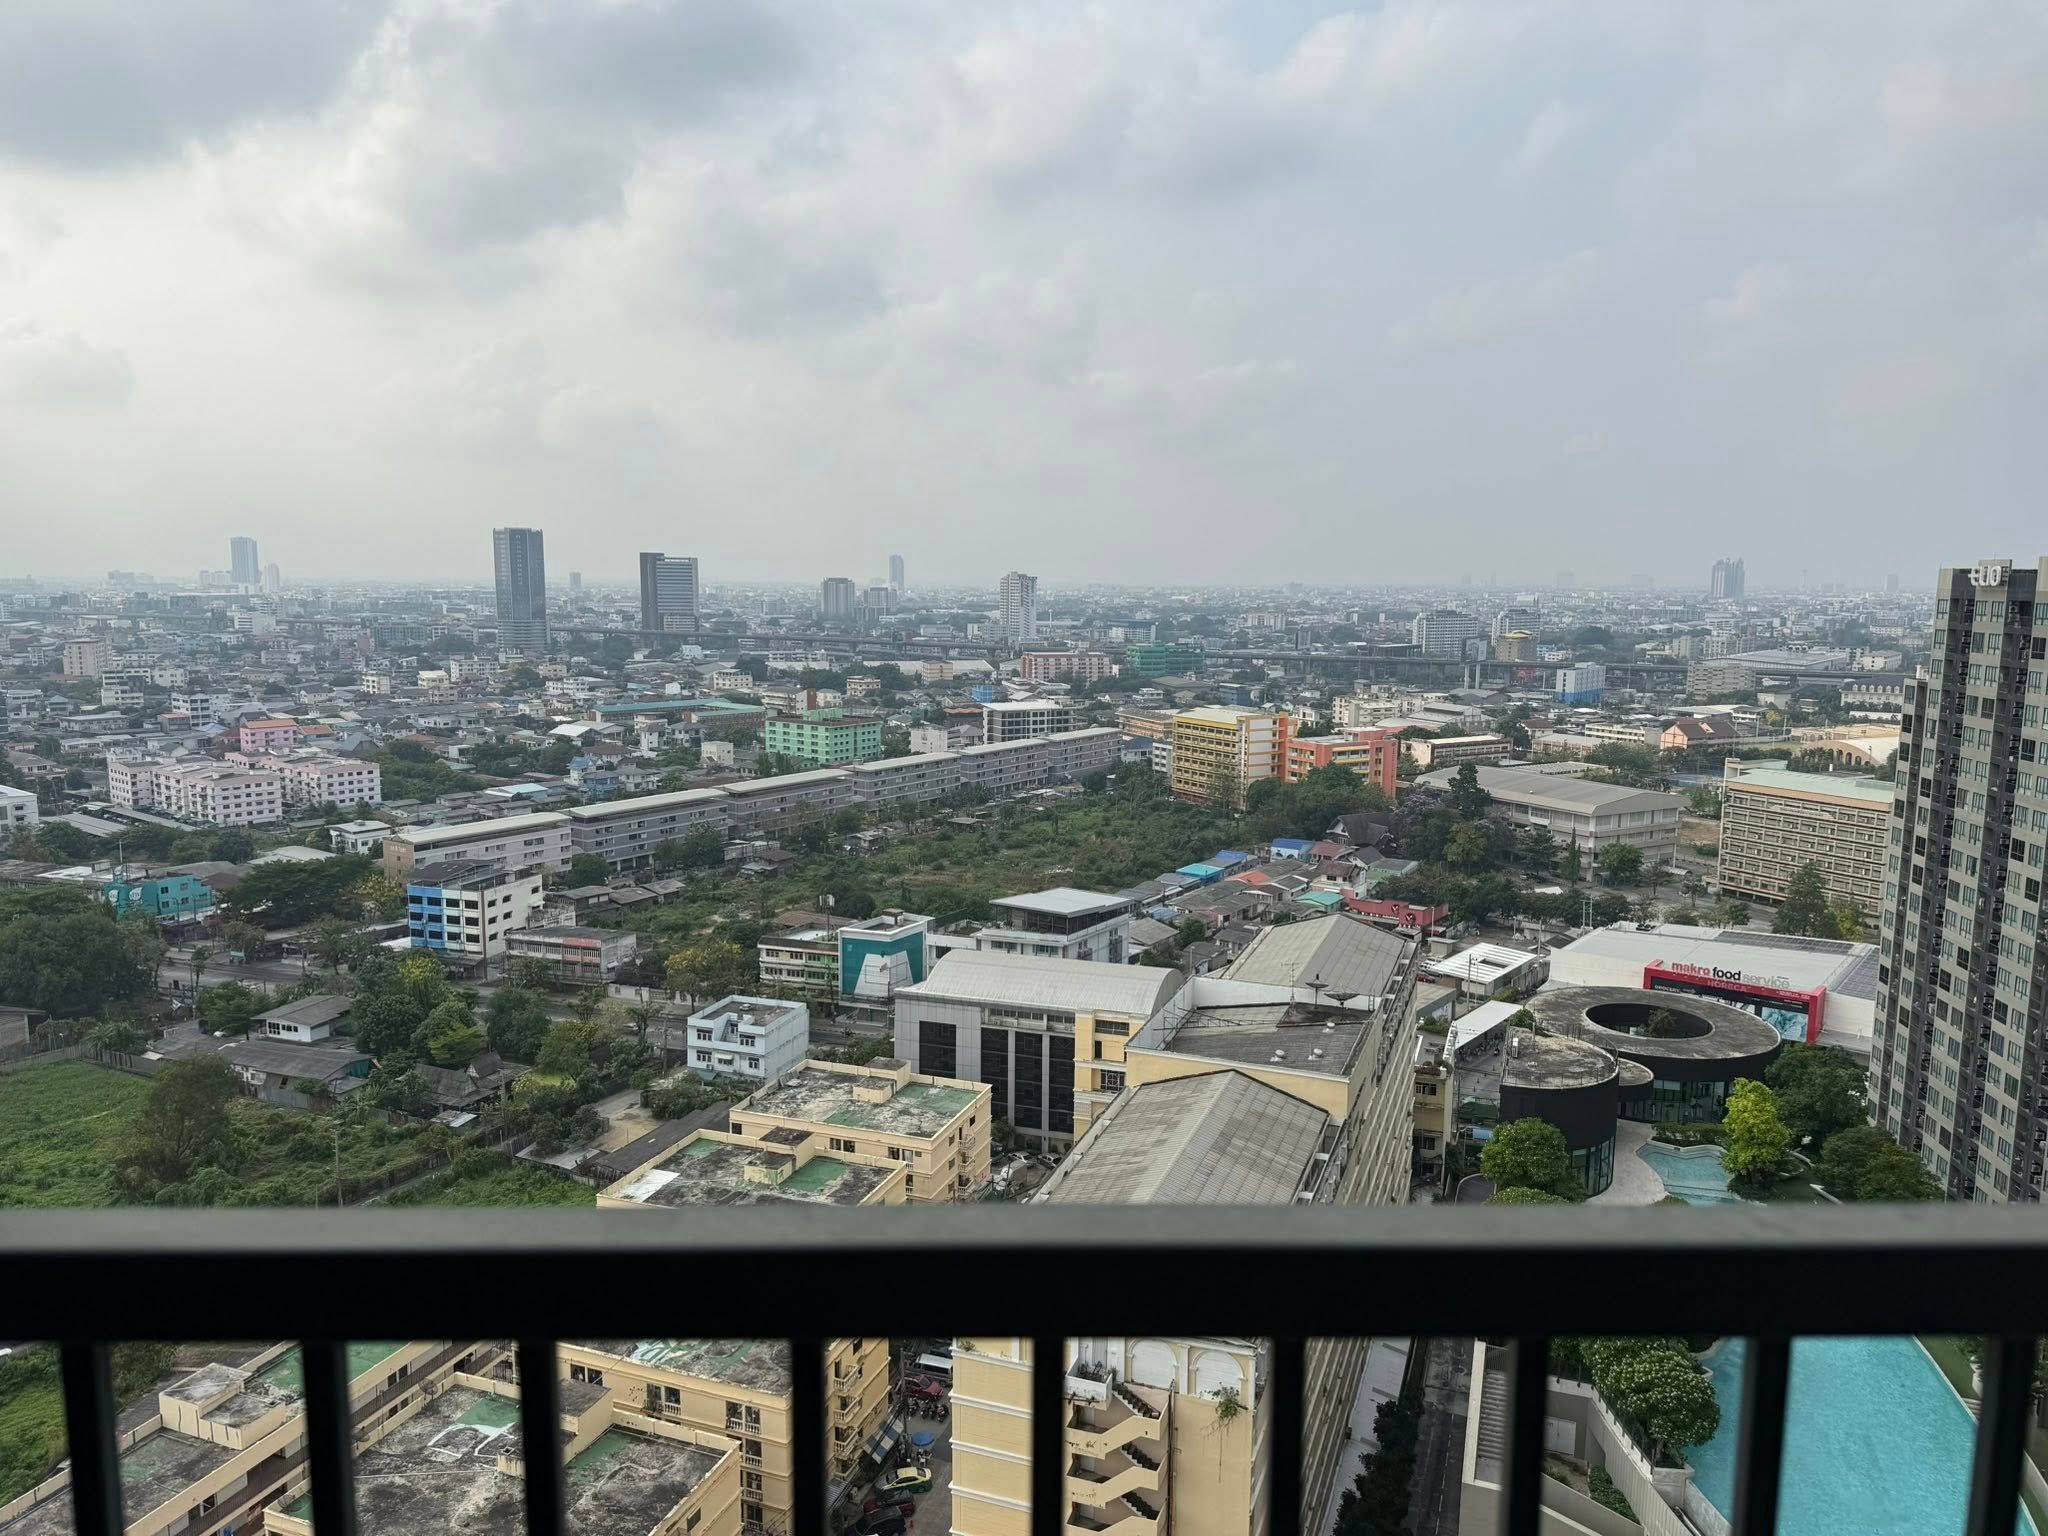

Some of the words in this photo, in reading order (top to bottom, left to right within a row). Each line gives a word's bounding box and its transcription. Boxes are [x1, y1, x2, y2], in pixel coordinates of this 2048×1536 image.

[1672, 962, 1710, 976] makro
[1713, 966, 1741, 981] food
[1743, 973, 1790, 988] service
